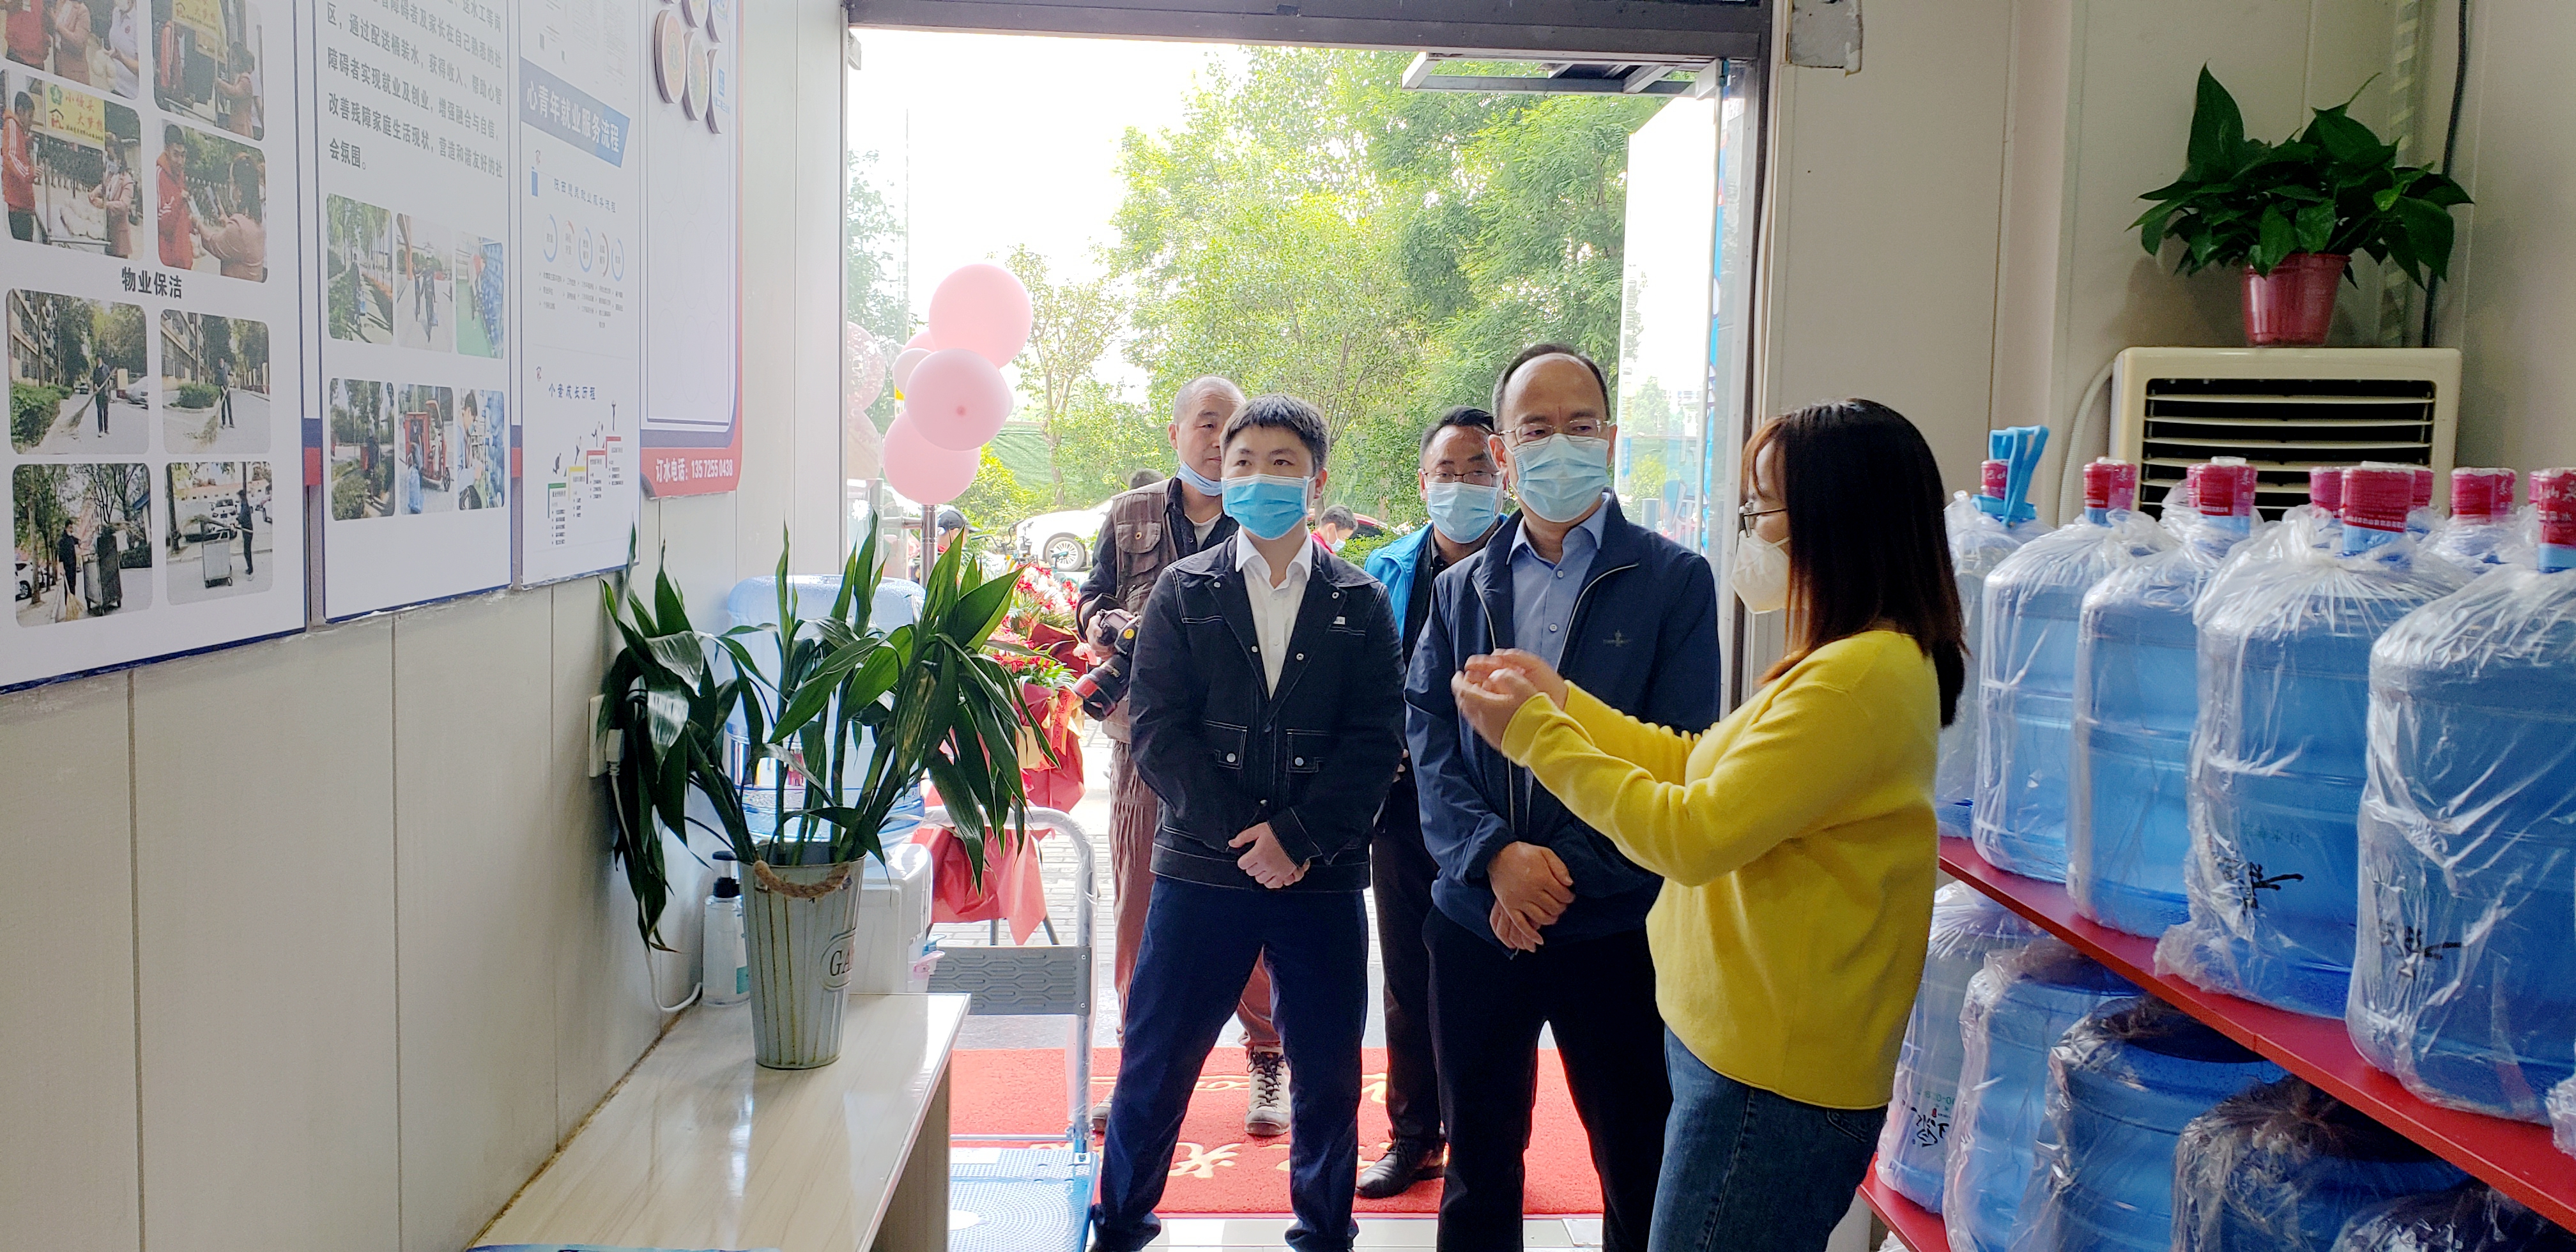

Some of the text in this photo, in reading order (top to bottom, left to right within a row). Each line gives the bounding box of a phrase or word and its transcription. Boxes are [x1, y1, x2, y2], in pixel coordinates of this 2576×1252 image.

[526, 80, 620, 153] 心青年就业服务流程
[329, 137, 366, 170] 会氛围。
[121, 266, 182, 299] 物业保洁
